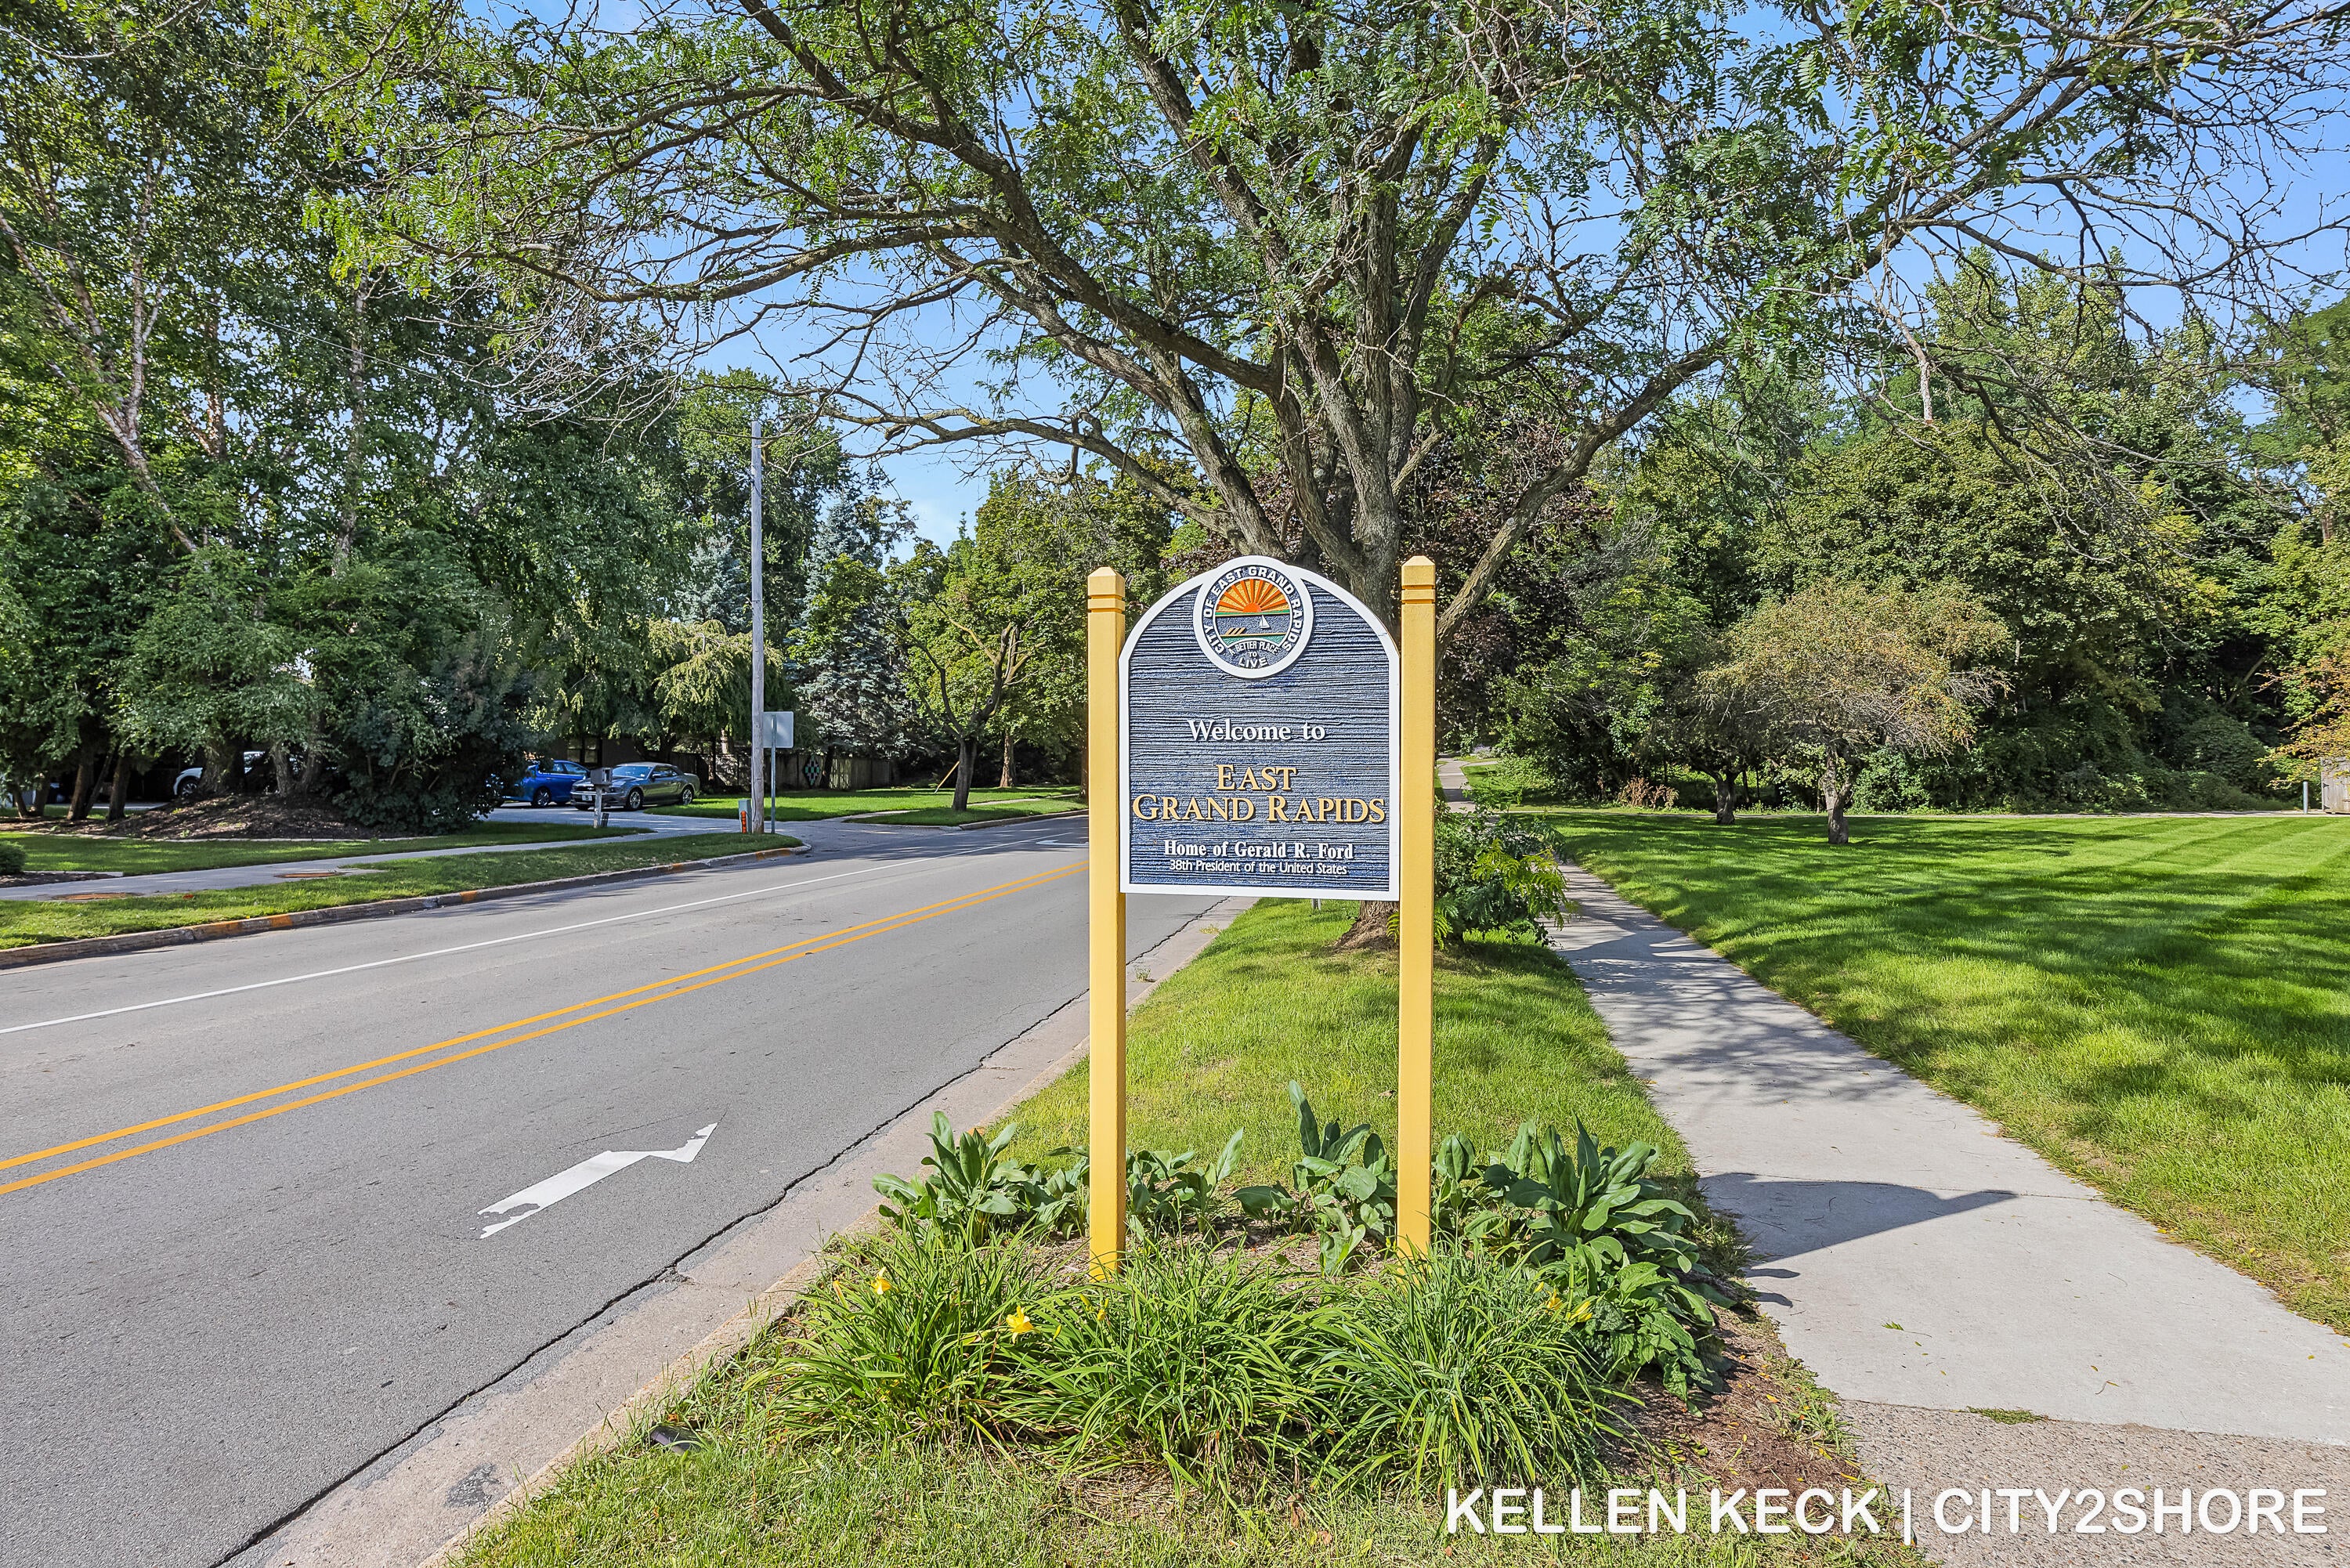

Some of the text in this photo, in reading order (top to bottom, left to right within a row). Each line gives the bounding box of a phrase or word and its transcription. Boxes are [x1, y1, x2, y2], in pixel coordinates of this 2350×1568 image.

[1203, 566, 1303, 653] CITY OF EAST GRAND RAPIDS
[1235, 641, 1256, 651] BETTER
[1259, 641, 1279, 656] PLACE
[1238, 656, 1268, 668] LIVE
[1188, 719, 1325, 741] Welcome to
[1215, 764, 1297, 791] EAST
[1133, 794, 1386, 822] GRAND RAPIDS
[1164, 840, 1354, 860] Home of Gerald R. Ford
[1170, 860, 1347, 875] 38th President of the United States
